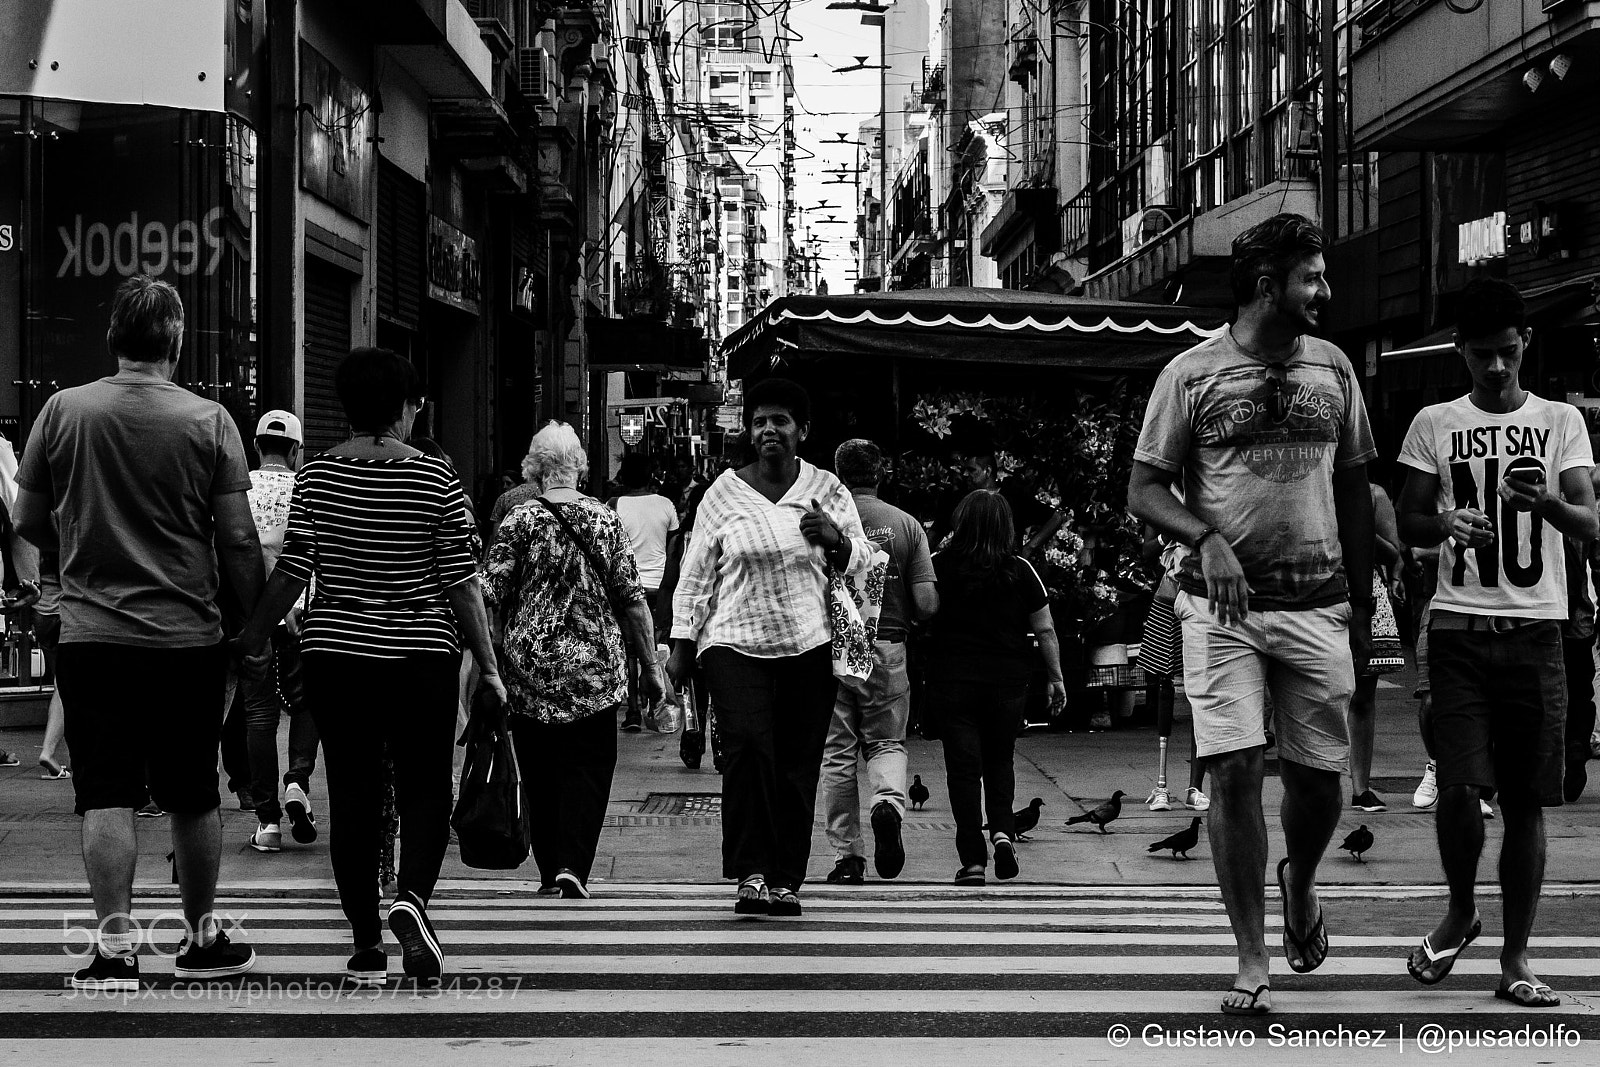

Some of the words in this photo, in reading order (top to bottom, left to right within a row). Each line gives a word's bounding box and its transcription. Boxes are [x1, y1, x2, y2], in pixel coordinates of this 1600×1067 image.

[1449, 426, 1502, 461] JUST
[1505, 425, 1551, 458] SAY
[1449, 456, 1548, 588] NO
